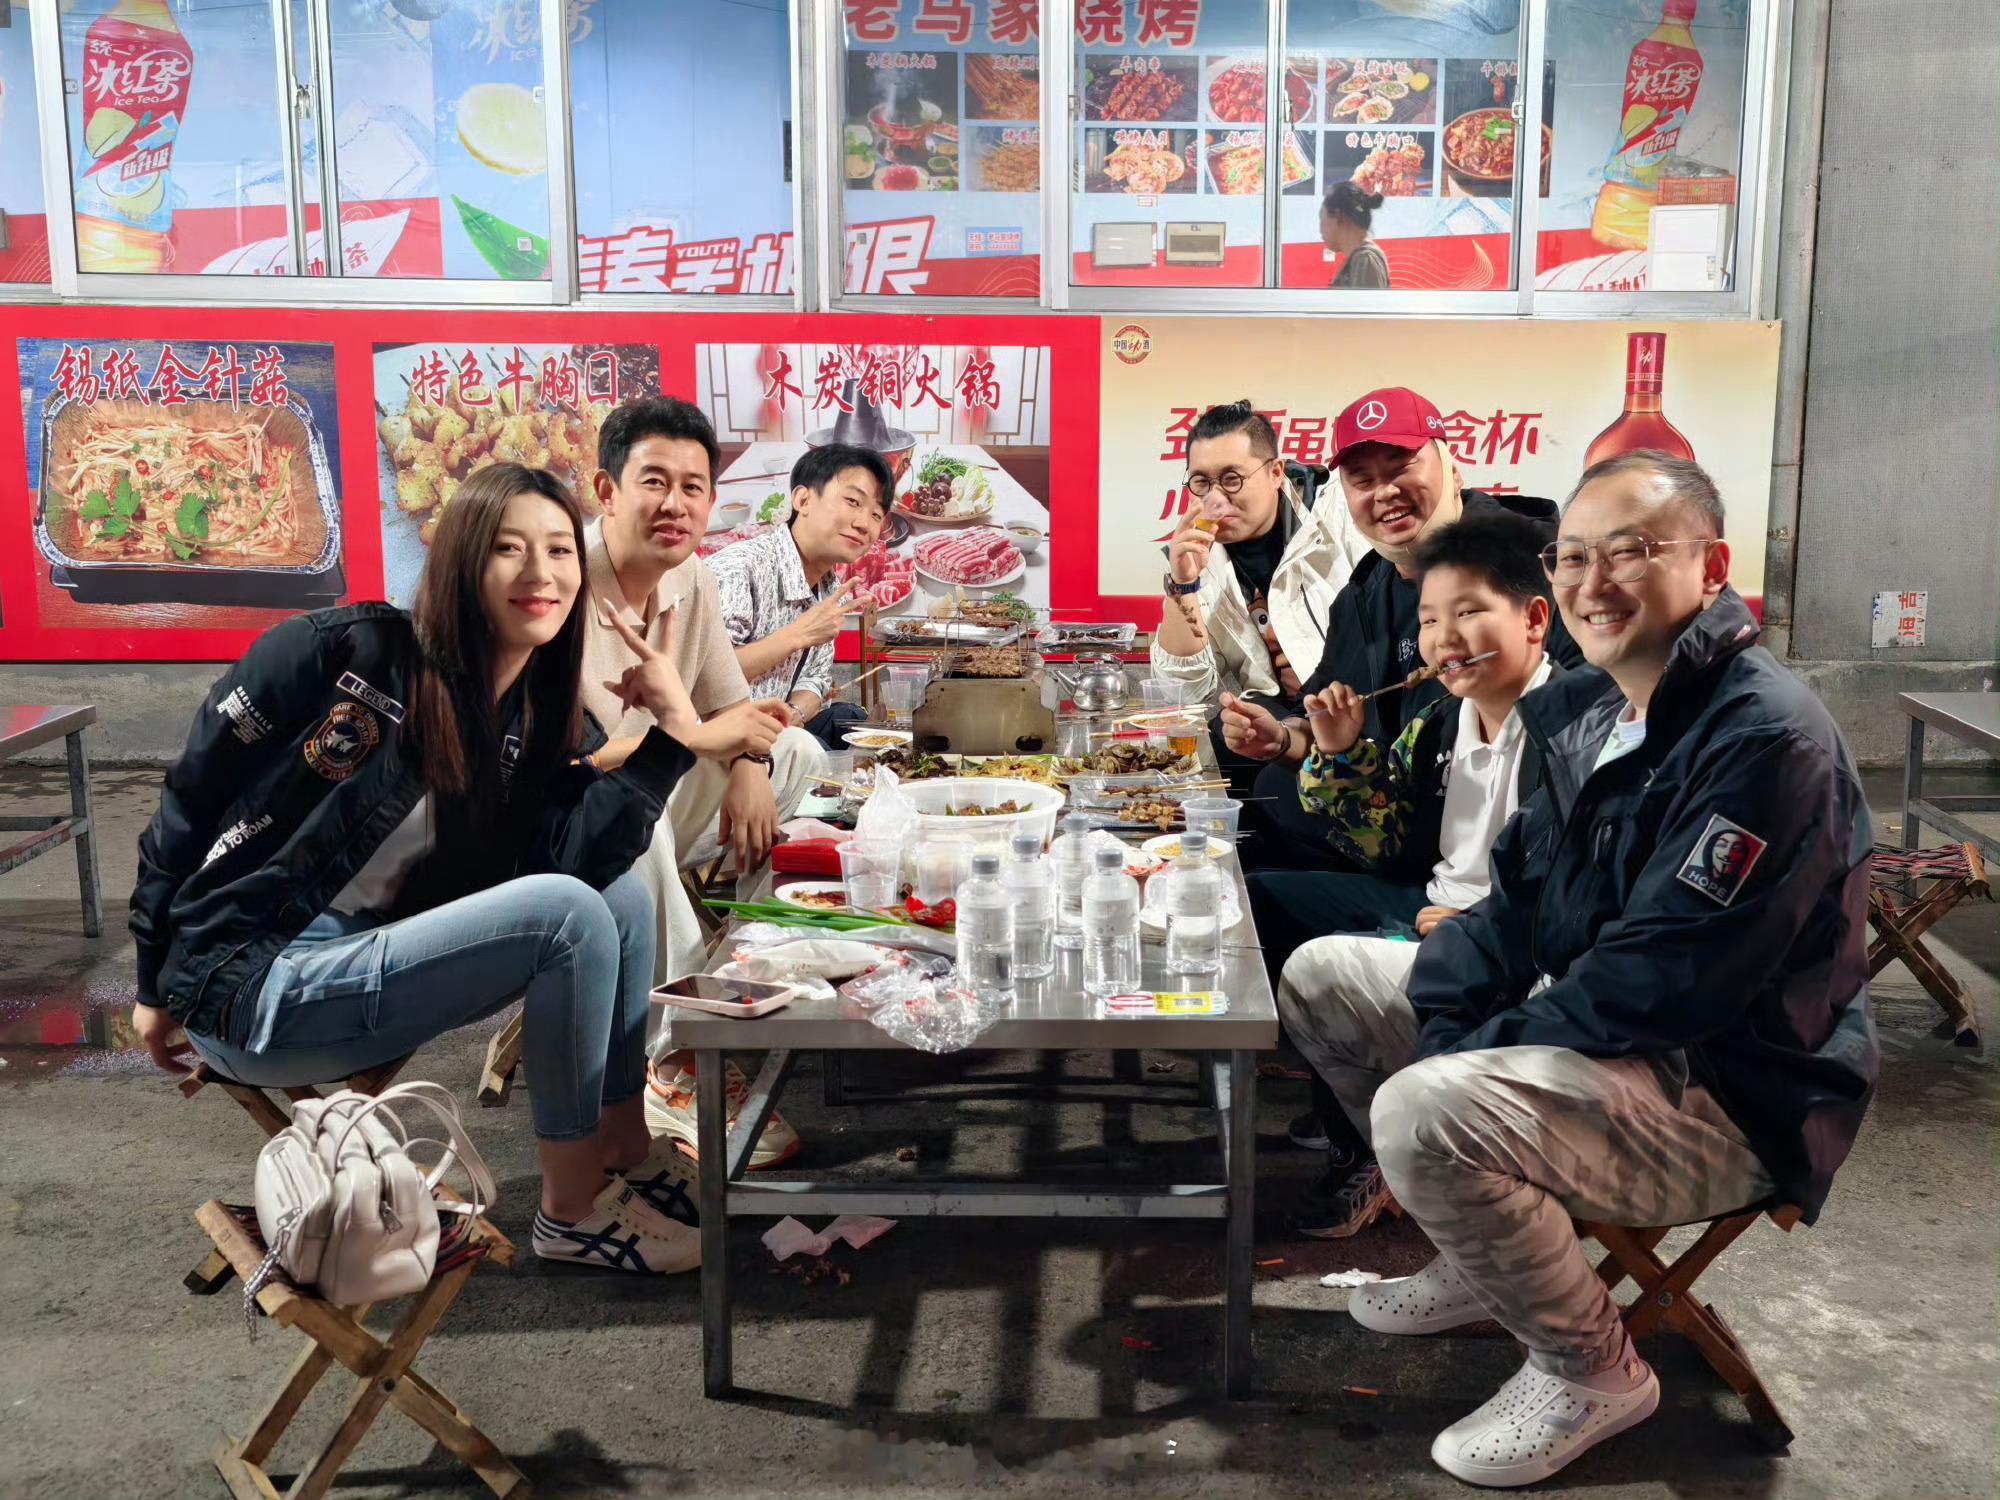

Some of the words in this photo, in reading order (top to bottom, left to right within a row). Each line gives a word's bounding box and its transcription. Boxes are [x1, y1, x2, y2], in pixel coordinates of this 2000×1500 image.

[89, 39, 132, 56] 统一
[84, 50, 192, 102] 冰红茶
[1626, 62, 1701, 100] 冰红茶
[114, 96, 133, 106] Ice
[676, 241, 737, 259] YOUTH
[49, 343, 291, 409] 锡纸金针菇
[411, 346, 621, 412] 特色牛胸口
[764, 350, 1001, 413] 木炭铜火锅
[350, 681, 391, 711] LEGEND
[241, 814, 273, 839] ROAM
[1688, 870, 1728, 898] HOPE
